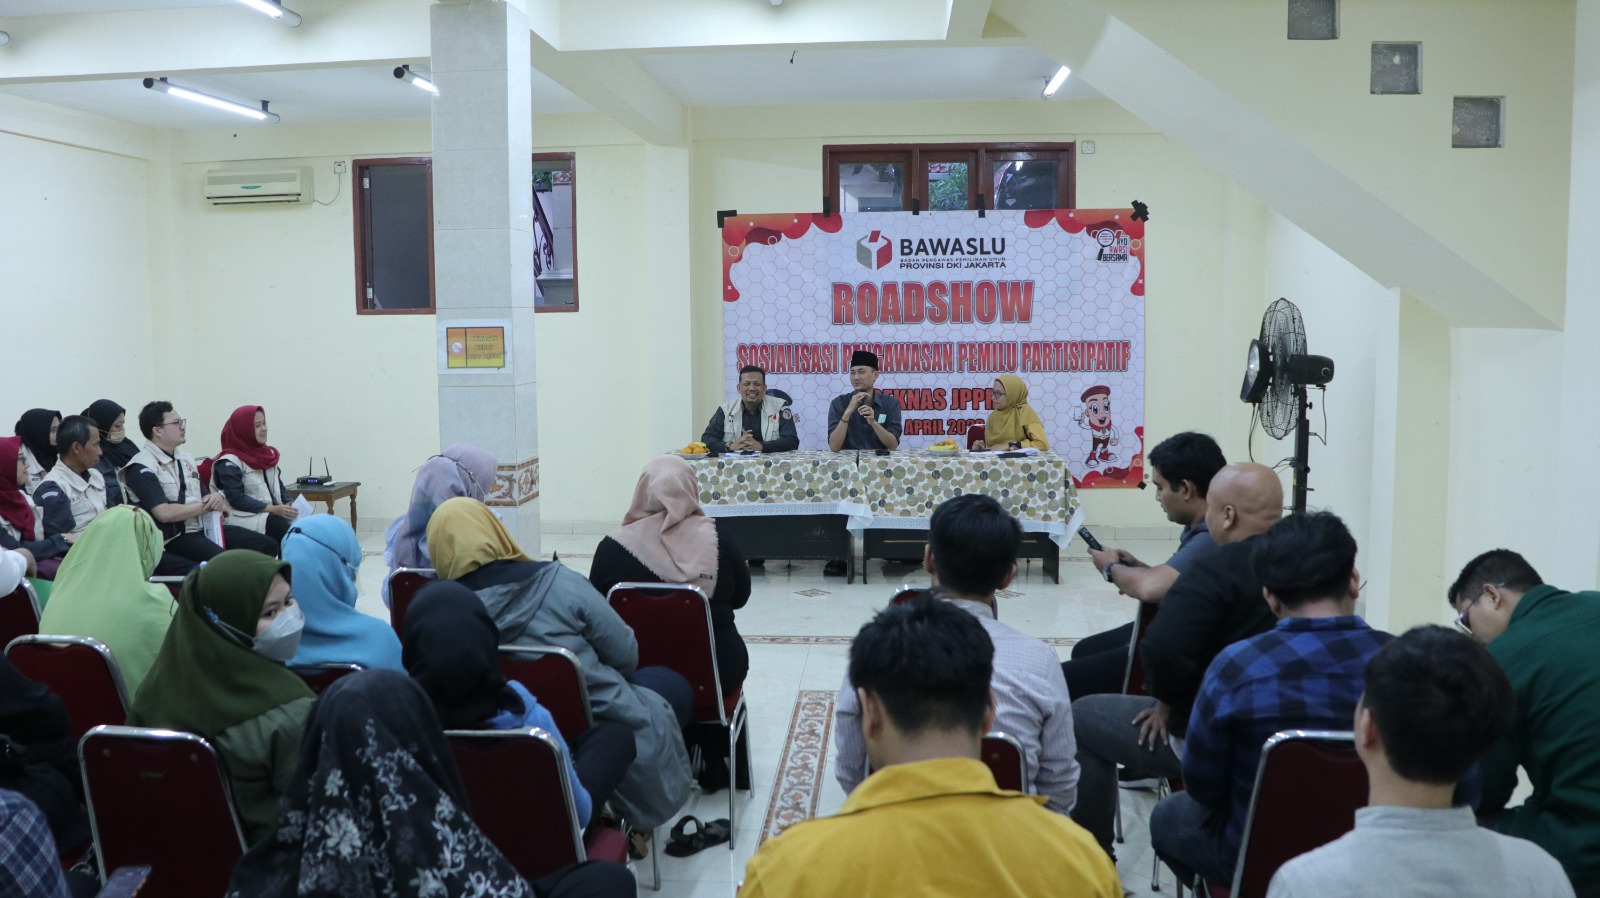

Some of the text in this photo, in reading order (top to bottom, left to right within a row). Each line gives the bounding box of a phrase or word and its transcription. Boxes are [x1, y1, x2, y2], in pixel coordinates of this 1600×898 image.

[900, 238, 1006, 256] BAWASLU
[832, 280, 1035, 326] ROADSHOW
[736, 340, 1131, 374] SOSIALISASI PGAWASAN PEMILU PARTISIPATIF
[904, 418, 945, 435] APRIL
